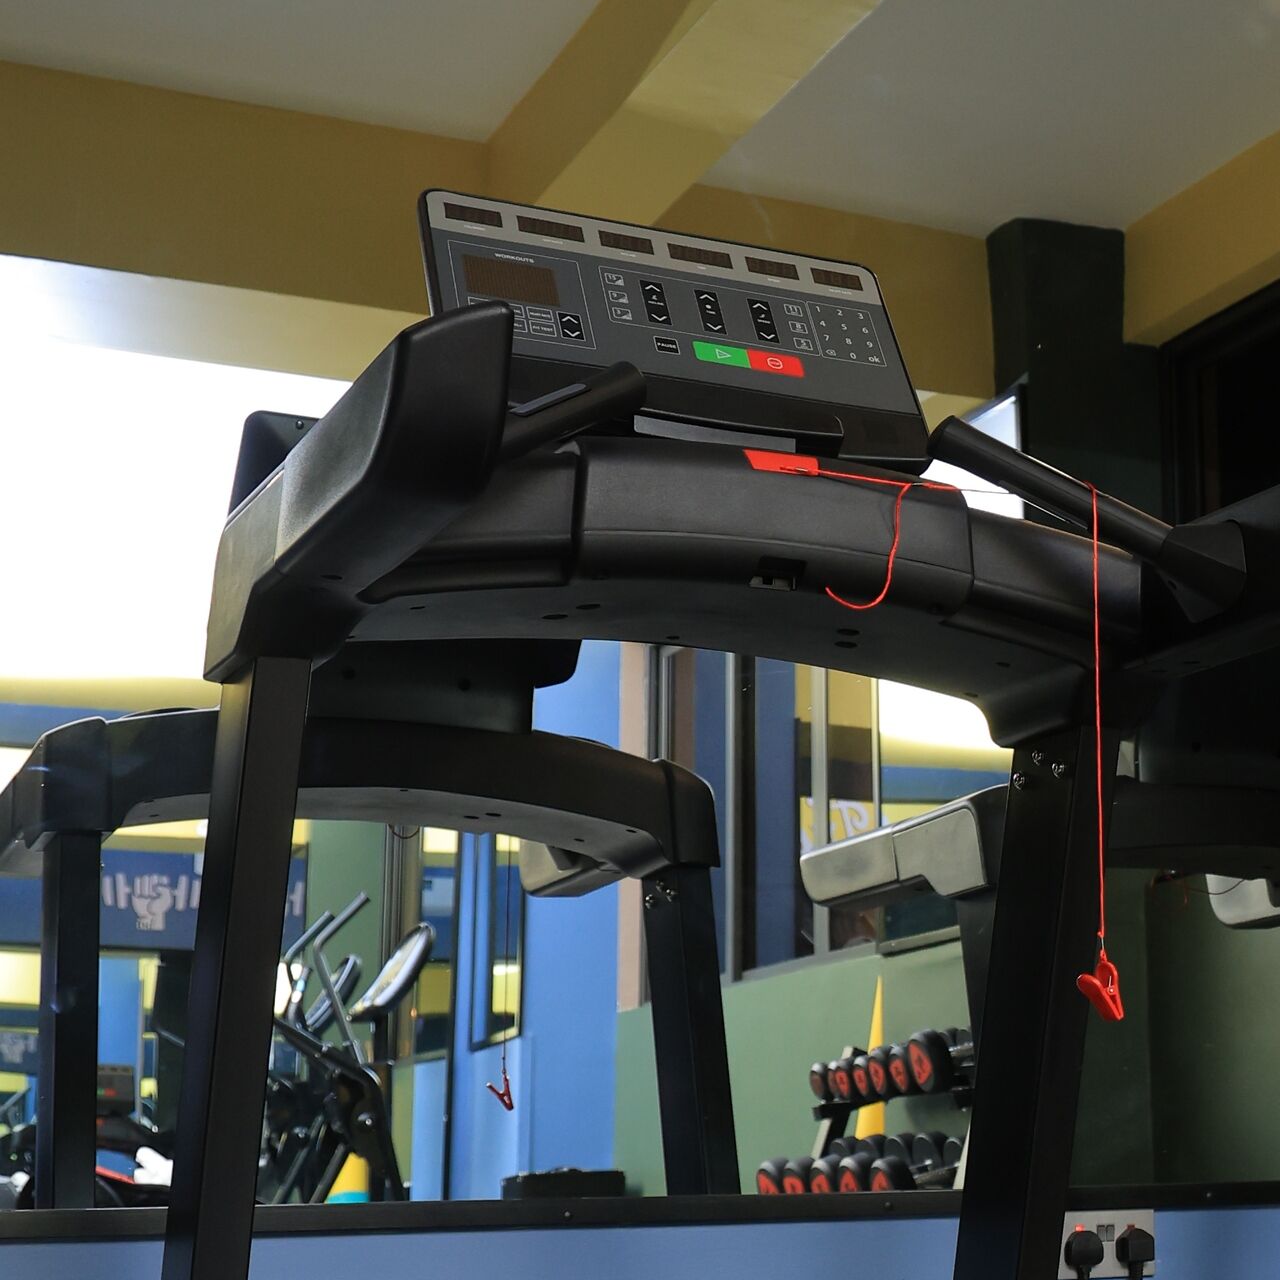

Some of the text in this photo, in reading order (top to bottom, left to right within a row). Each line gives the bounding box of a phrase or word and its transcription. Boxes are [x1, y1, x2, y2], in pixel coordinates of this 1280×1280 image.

[494, 252, 535, 264] WORKOUTS
[866, 341, 873, 349] 9
[868, 355, 881, 363] ok
